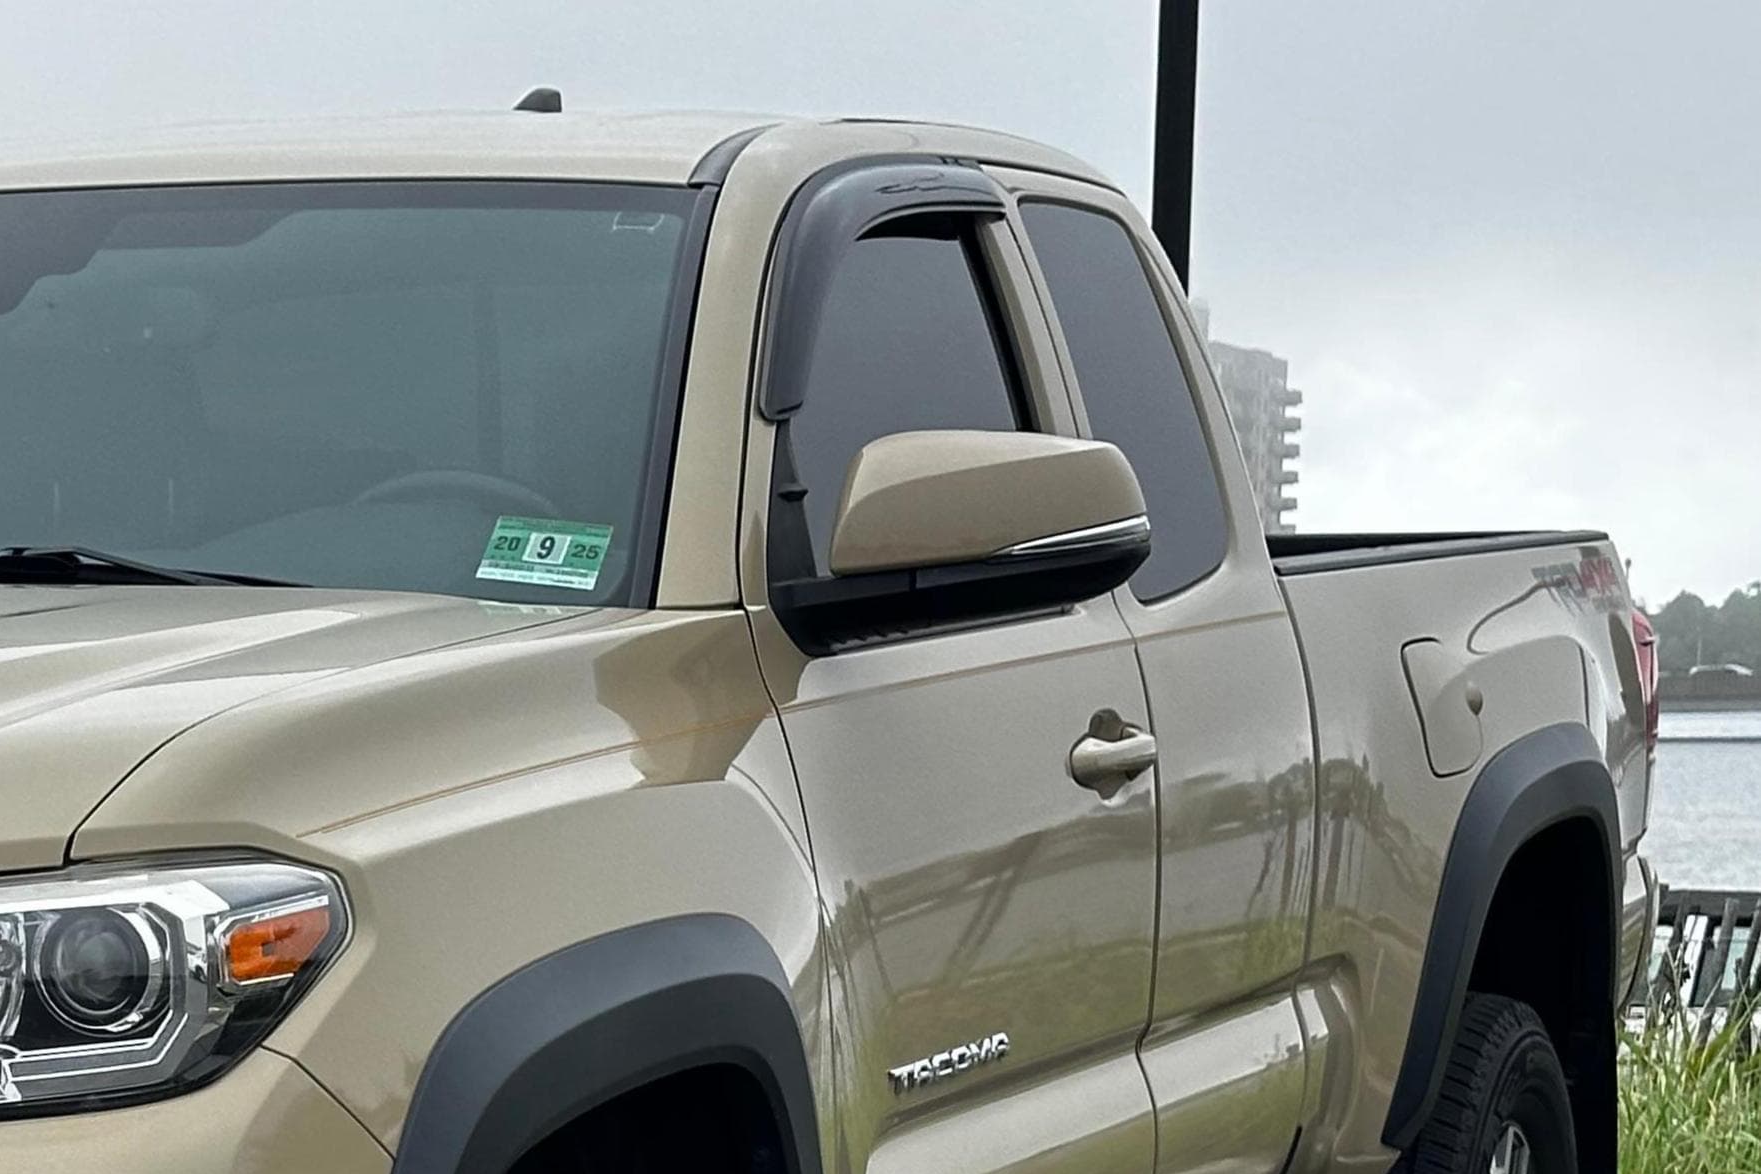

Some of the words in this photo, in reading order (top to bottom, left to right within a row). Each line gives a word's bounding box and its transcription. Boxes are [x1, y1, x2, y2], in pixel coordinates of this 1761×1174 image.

[493, 535, 522, 551] 20
[536, 535, 556, 560] 9
[571, 543, 601, 560] 25
[888, 1032, 1009, 1092] TACOMA
